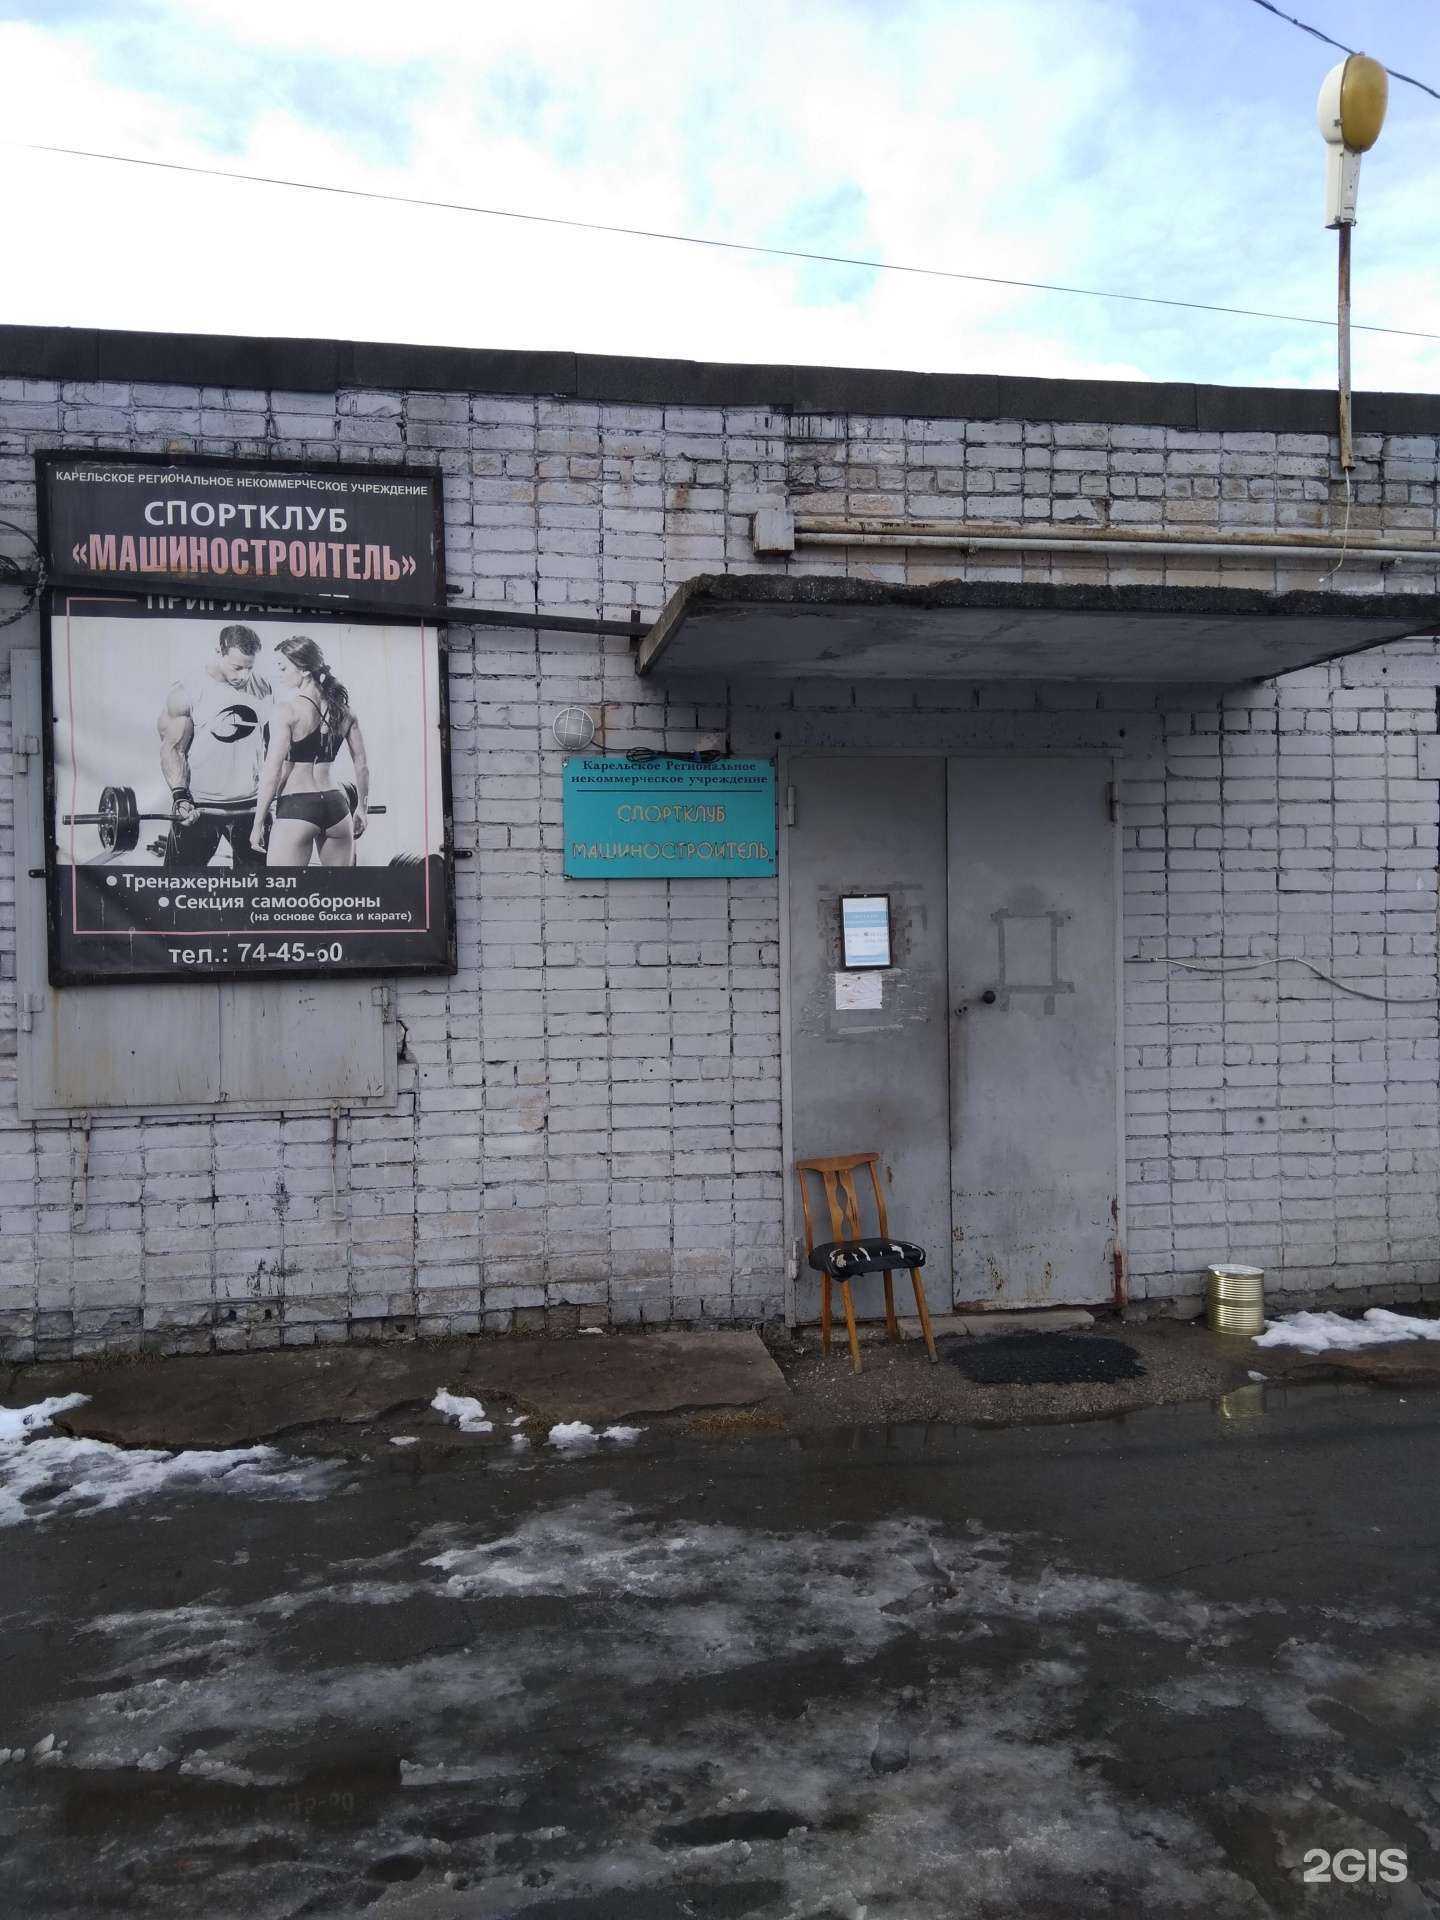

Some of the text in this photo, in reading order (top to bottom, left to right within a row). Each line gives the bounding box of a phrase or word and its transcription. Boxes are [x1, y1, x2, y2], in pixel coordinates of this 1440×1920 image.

[56, 470, 428, 496] КАРЕЛЬСКОЕ РЕГИОНАЛЬНОЕ НЕКОММЕРЧЕСКОЕ УЧРЕЖДЕНИЕ
[144, 501, 348, 533] СПОРТКЛУБ
[72, 533, 417, 582] «МАШИНОСТРОИТЕЛЬ»
[583, 760, 756, 772] Карельское Региональное
[571, 775, 768, 787] некоммерческое учреждение
[617, 804, 726, 824] СПОРТКЛУБ
[572, 841, 769, 862] МАШИНОСТРОИТЕЛЬ
[122, 872, 297, 892] Тренажерный зал
[175, 893, 381, 911] Секция самообороны
[250, 911, 413, 923] (на основе бокса и карате)
[168, 947, 228, 964] тел.:
